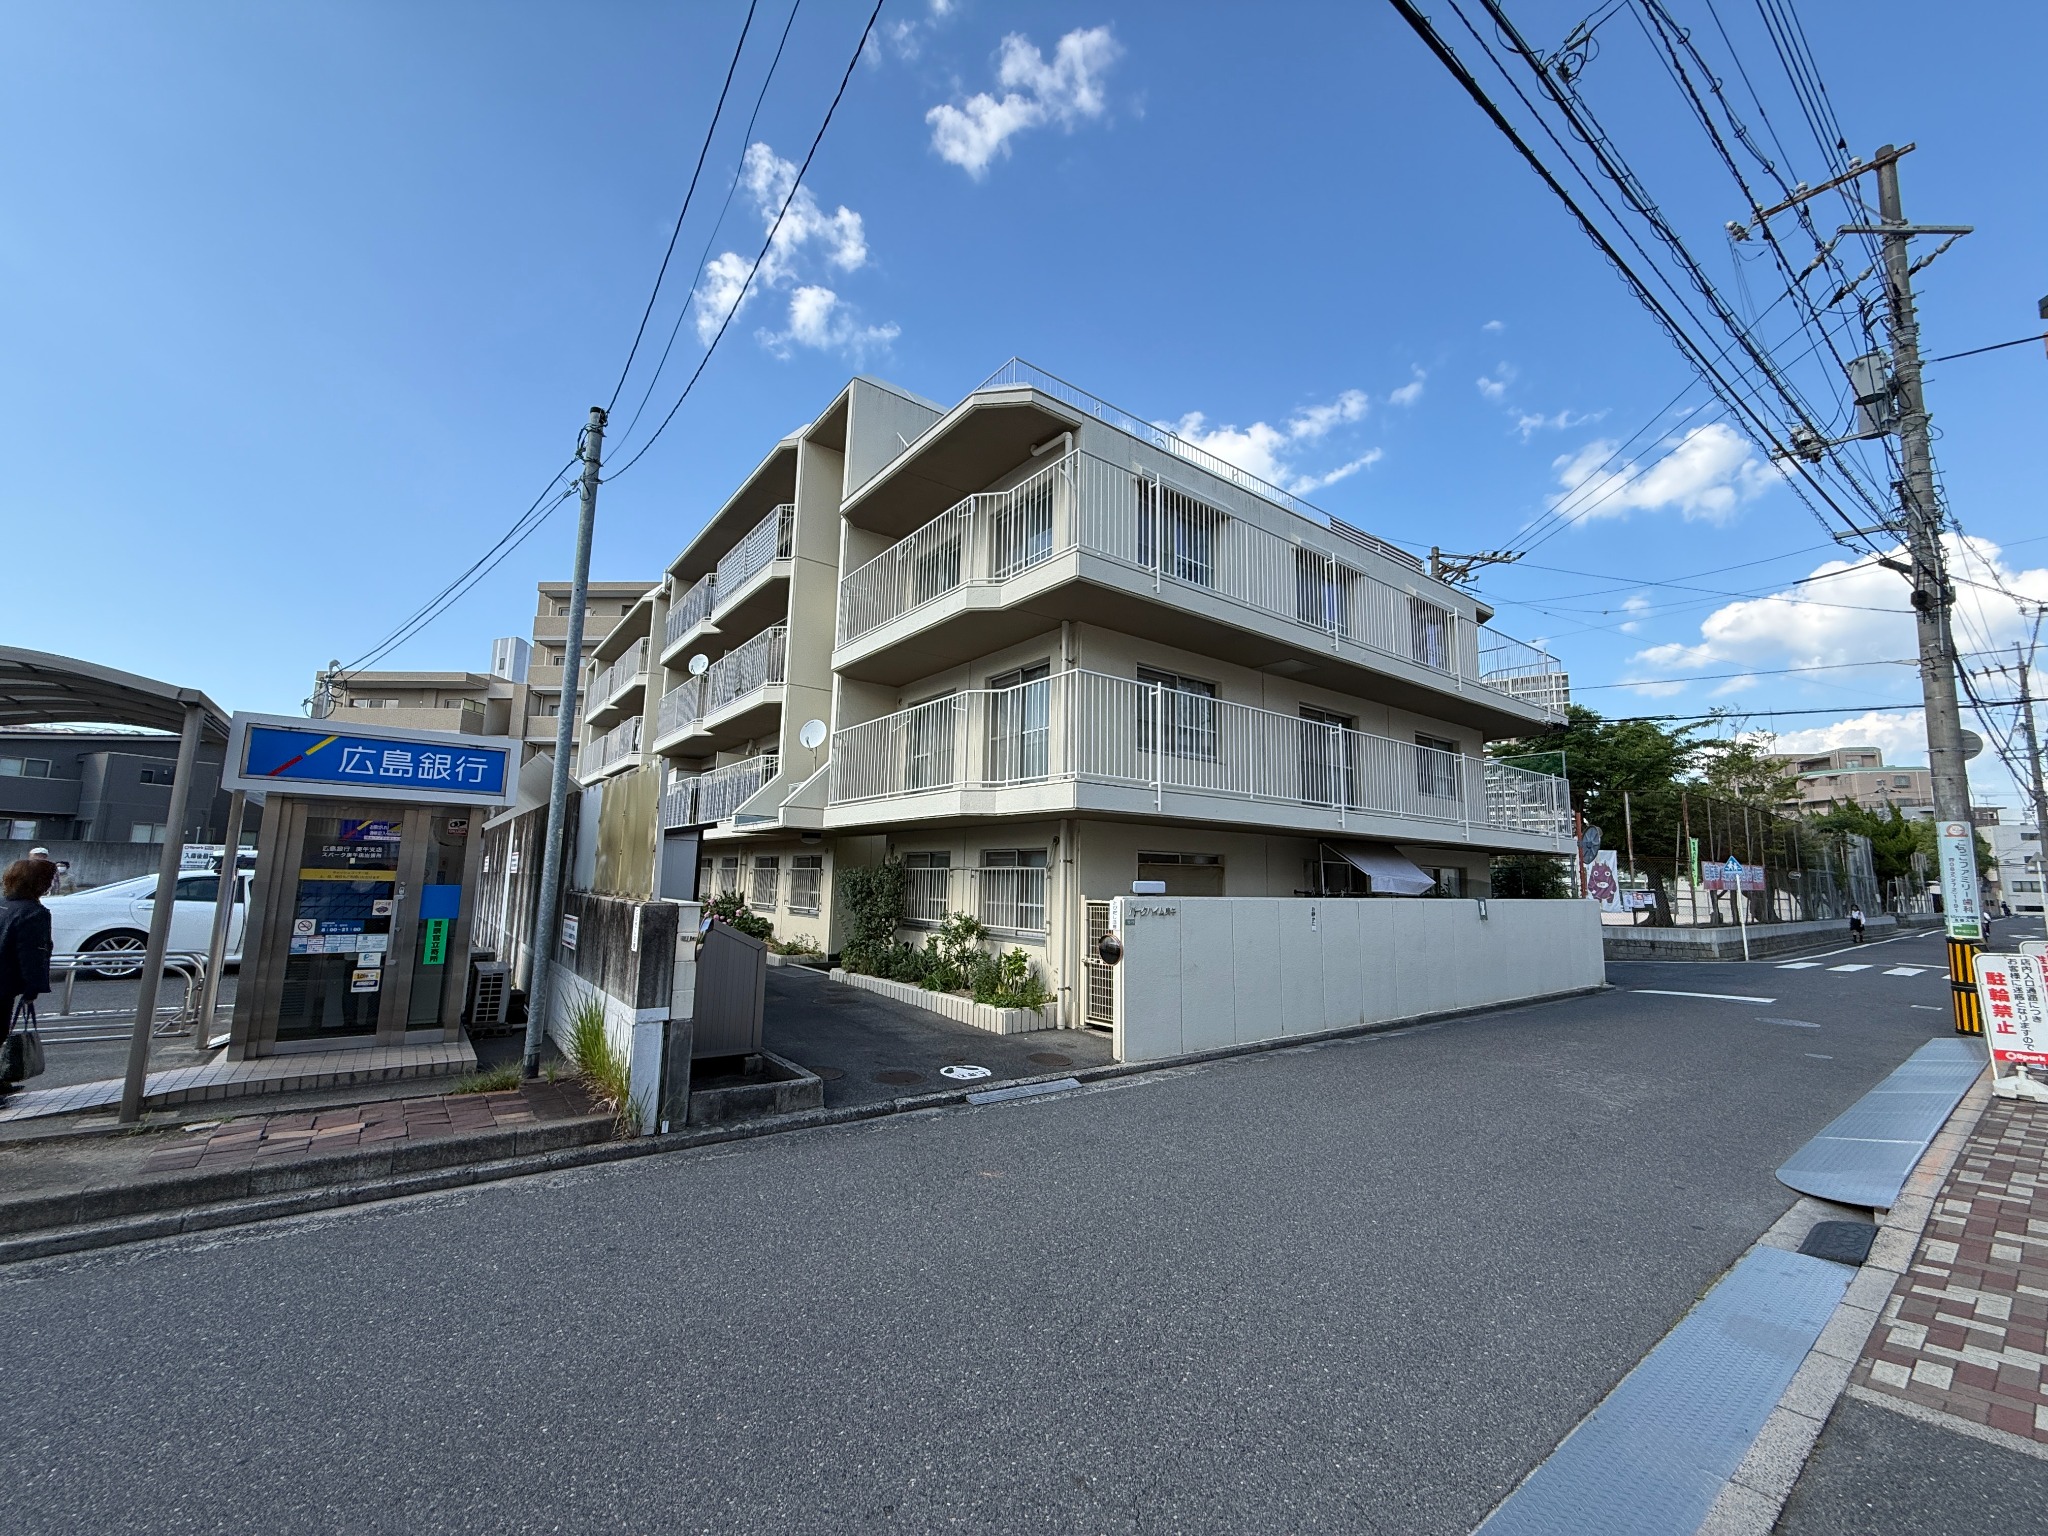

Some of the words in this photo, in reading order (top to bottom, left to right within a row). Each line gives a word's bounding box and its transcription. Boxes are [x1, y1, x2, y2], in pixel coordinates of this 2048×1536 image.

[338, 746, 489, 783] 広島銀行
[1985, 971, 2017, 1035] 駐輪禁止
[2007, 958, 2035, 1051] お客様に迷惑となりますので
[2020, 958, 2042, 1023] 店内入口通路につき
[2015, 1053, 2047, 1062] Spark
